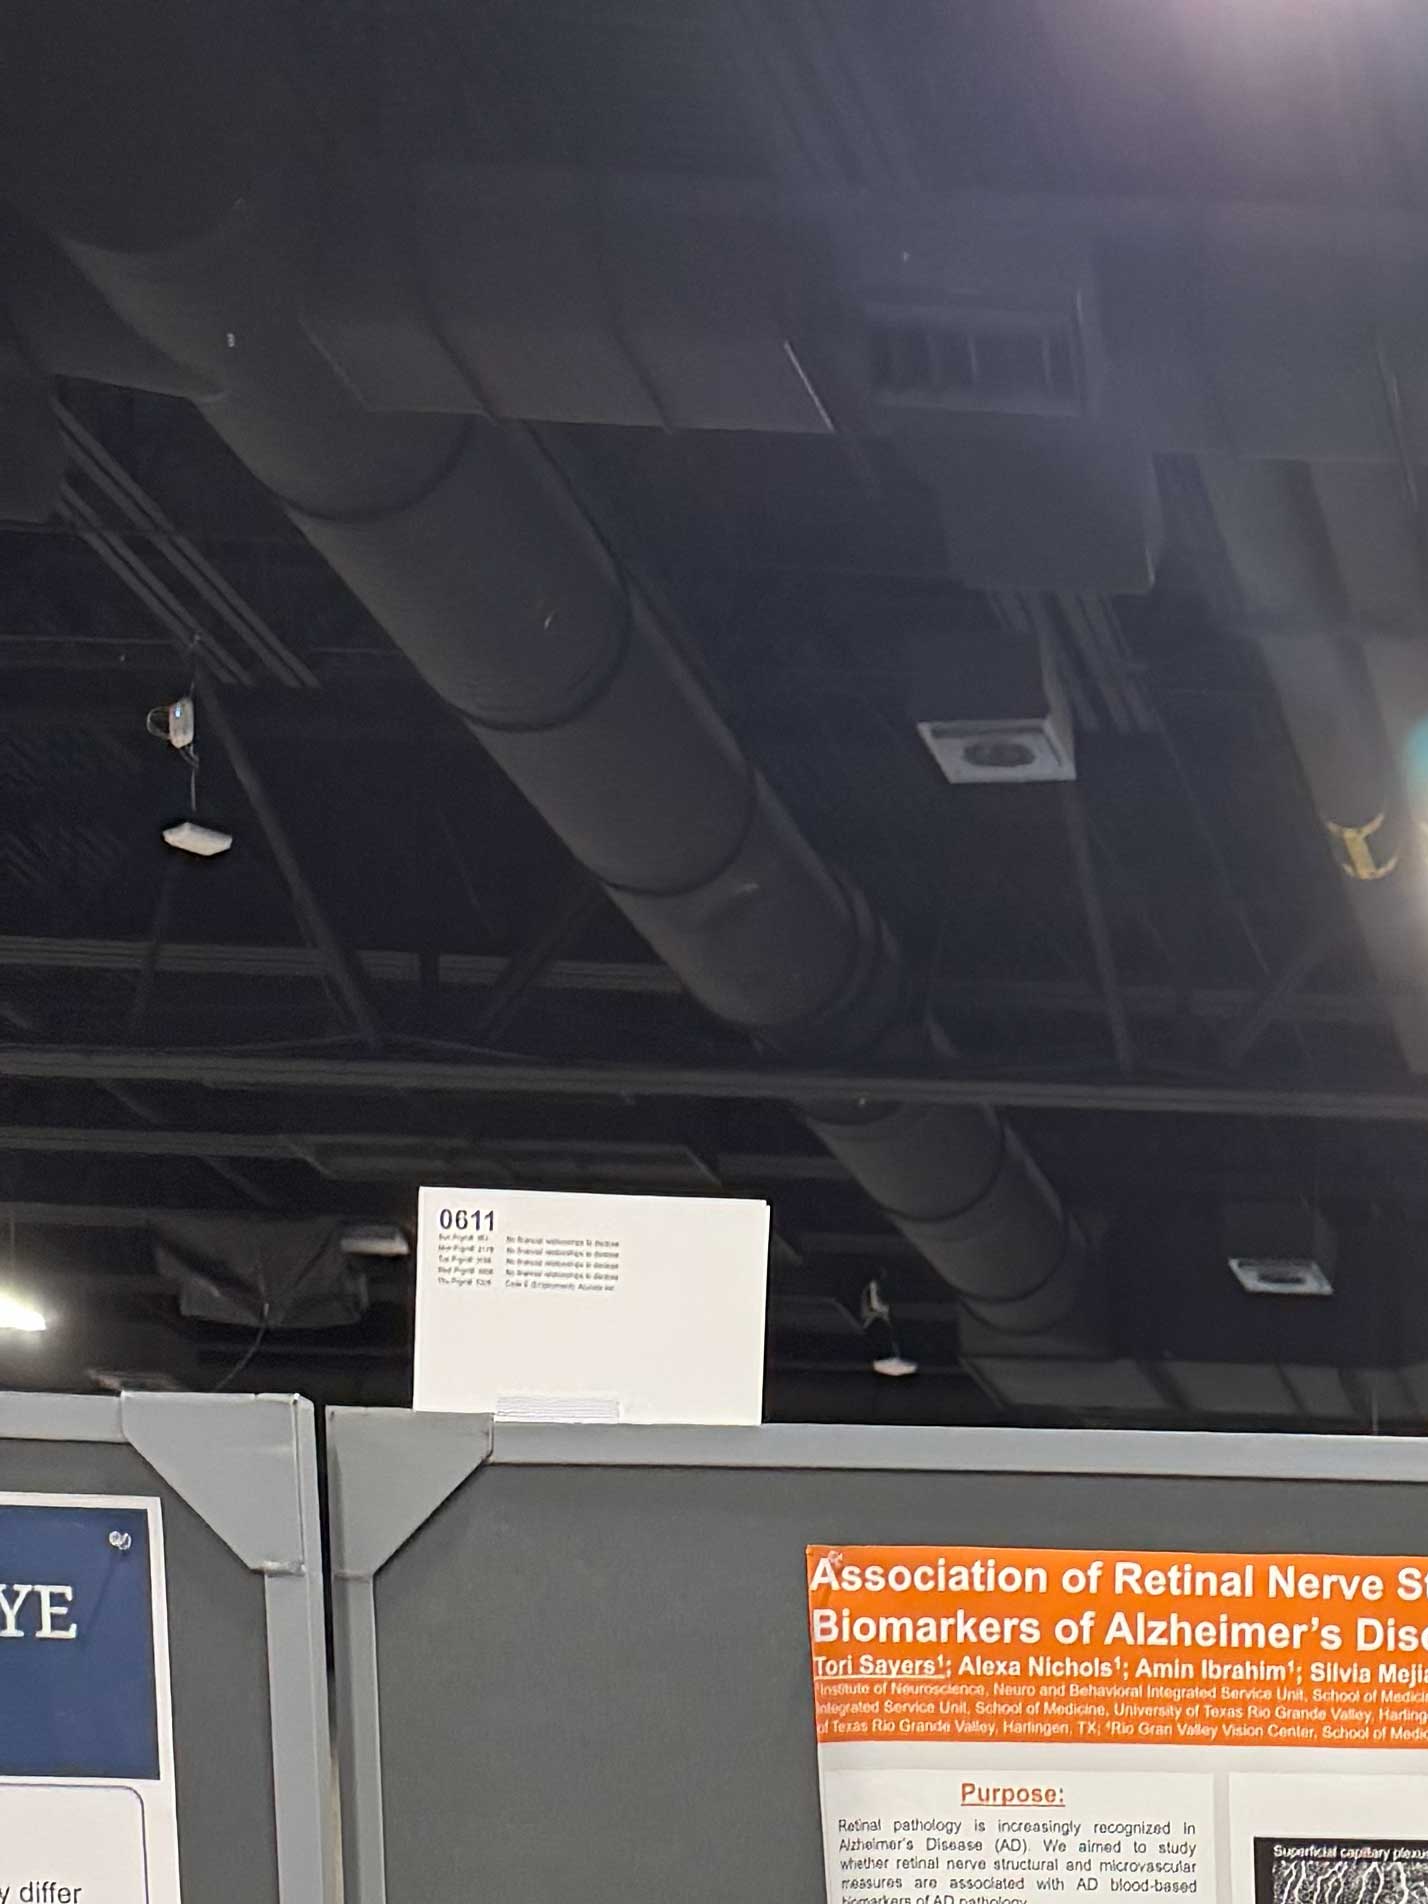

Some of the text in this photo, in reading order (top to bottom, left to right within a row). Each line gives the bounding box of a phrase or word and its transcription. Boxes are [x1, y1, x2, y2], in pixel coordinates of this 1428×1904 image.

[439, 1209, 496, 1232] 0611
[805, 1558, 1046, 1597] Association
[1063, 1561, 1103, 1593] of
[1116, 1562, 1252, 1596] Retinal
[1269, 1566, 1382, 1600] Nerve
[0, 1584, 77, 1639] YE
[809, 1609, 1040, 1647] Biomarkers
[1055, 1612, 1095, 1644] of
[961, 1783, 1066, 1807] Purpose:
[839, 1819, 1195, 1838] Retinal pathology is increasingly recognized in
[20, 1881, 82, 1904] differ
